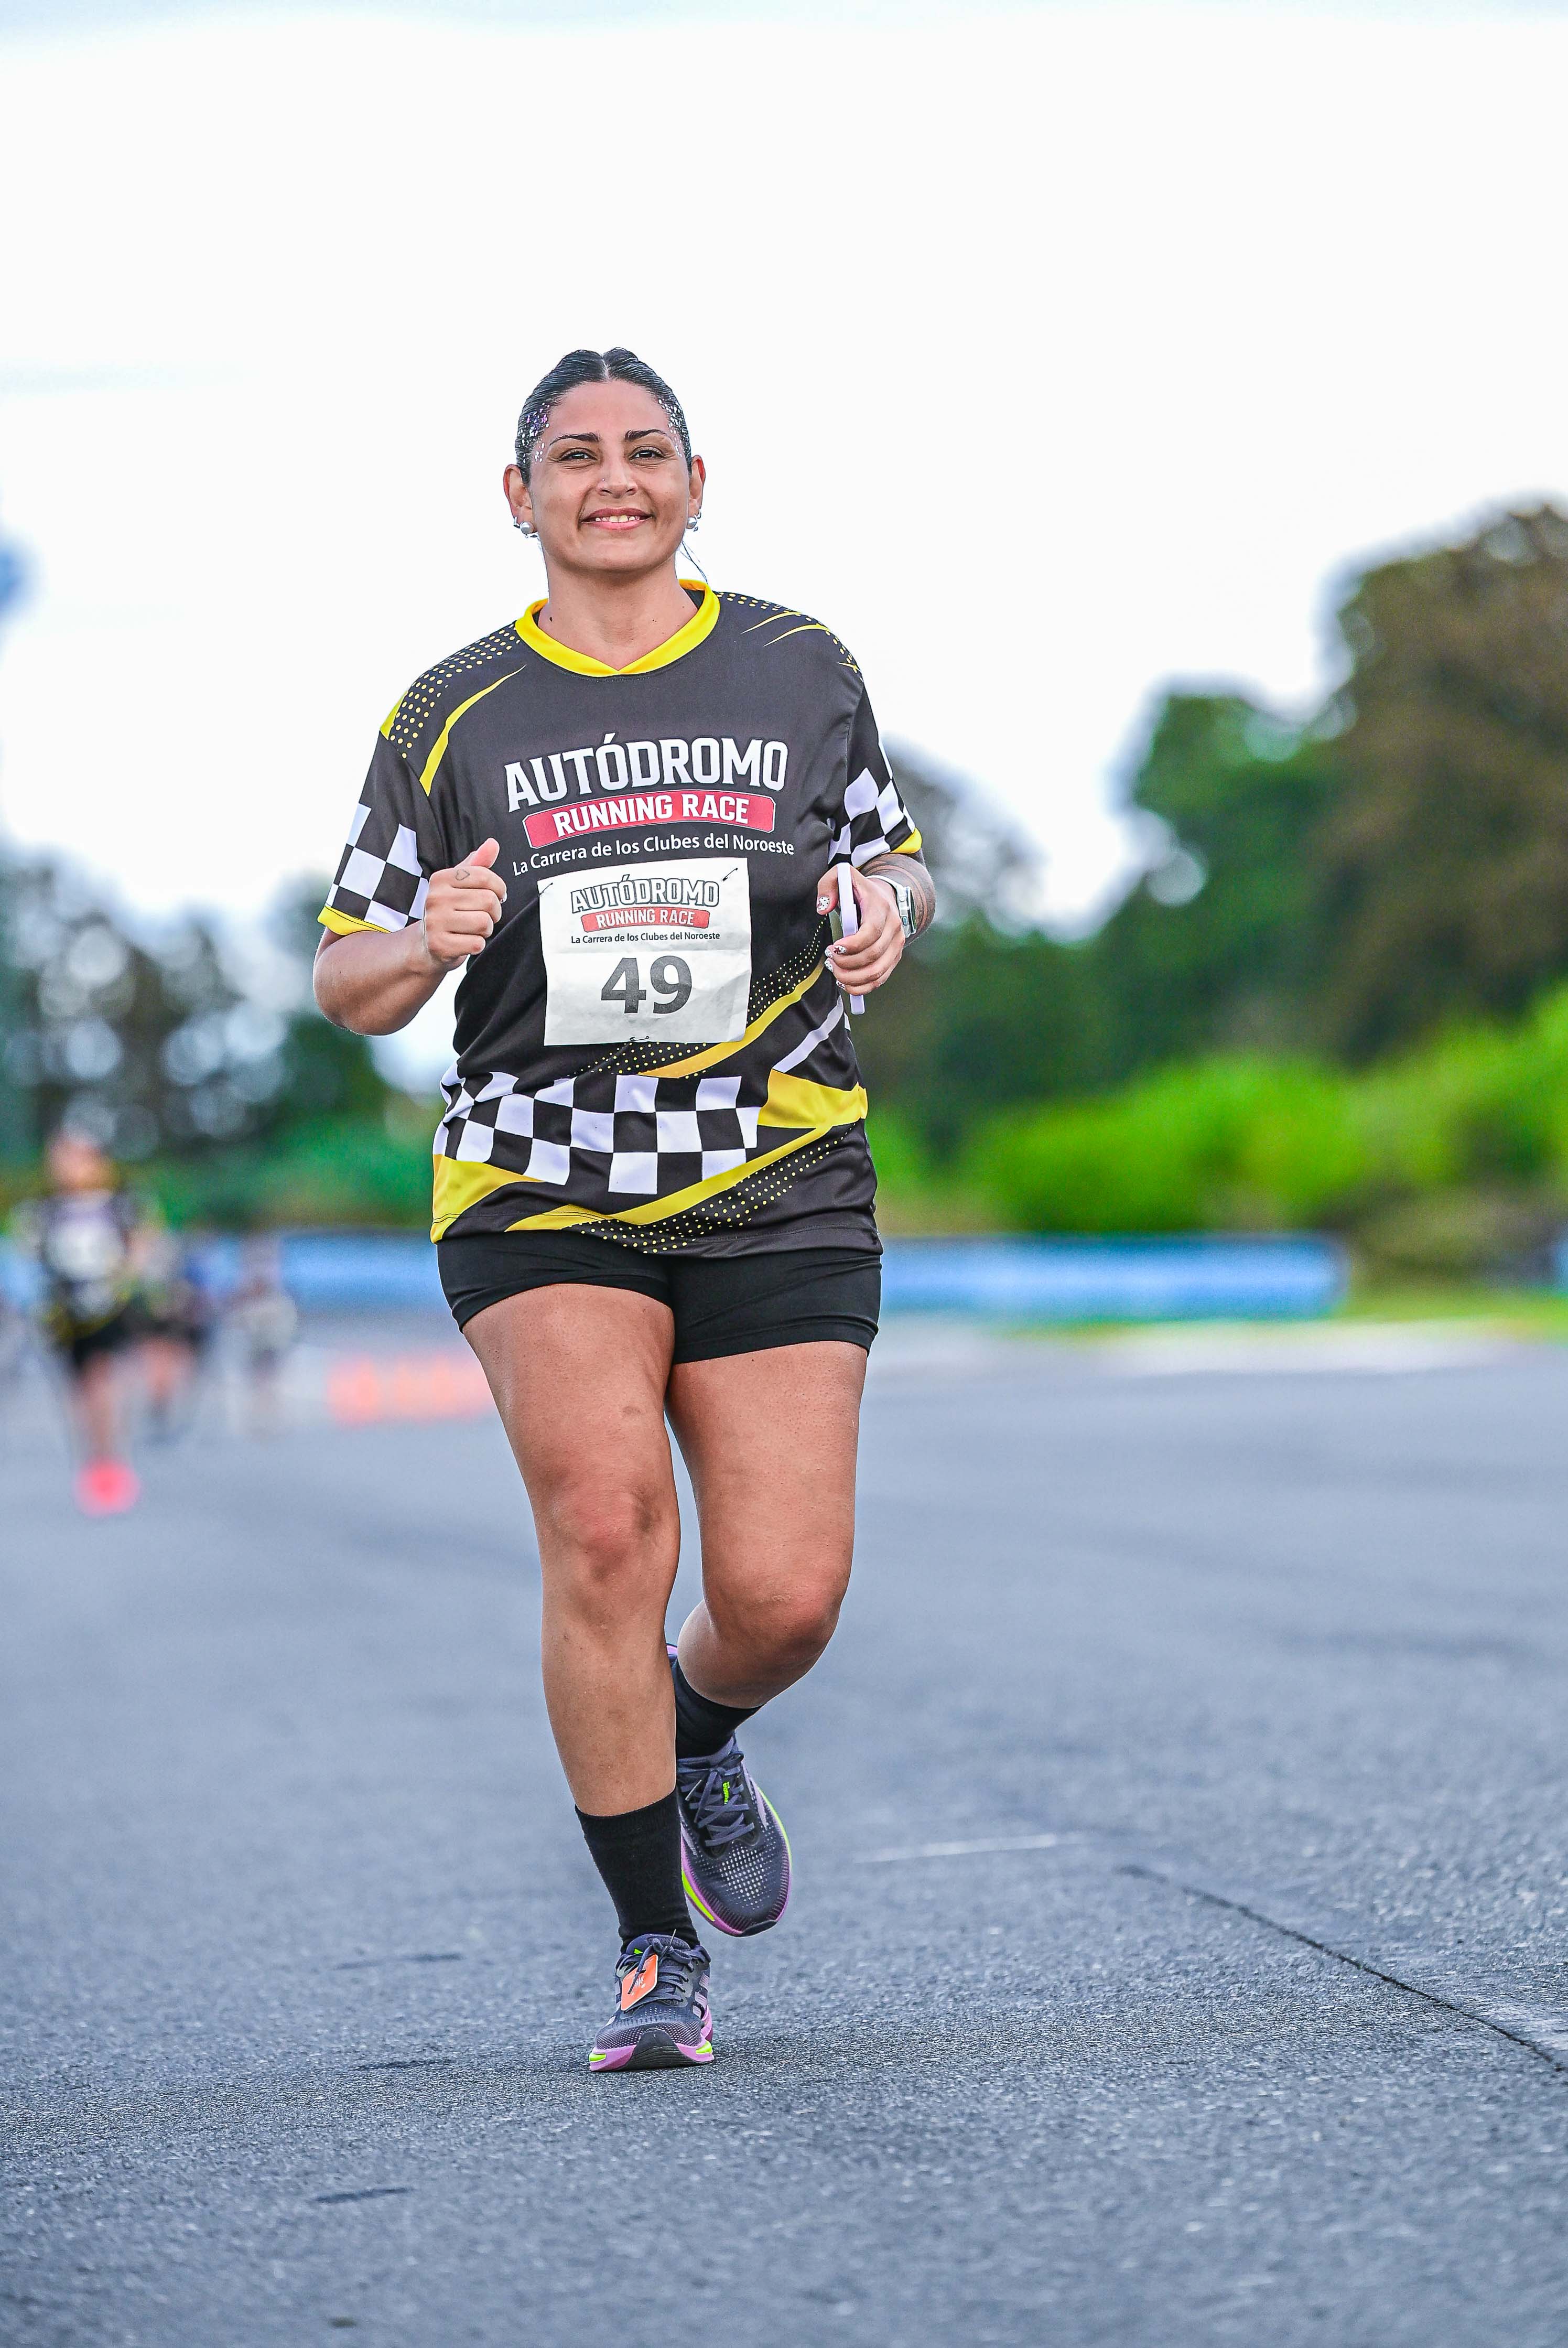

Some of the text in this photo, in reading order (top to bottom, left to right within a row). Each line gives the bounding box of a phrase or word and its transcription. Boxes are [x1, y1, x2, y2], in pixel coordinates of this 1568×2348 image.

[504, 732, 788, 812] AUTÓDROMO
[552, 794, 749, 837] RUNNING RACE
[513, 833, 794, 876] La Carrera de los Clubes del Noroeste
[570, 874, 720, 913] AUTÓDROMO
[582, 933, 612, 943] Carrera
[614, 933, 625, 942] de
[627, 933, 639, 942] los
[641, 932, 668, 941] Clubes
[670, 931, 683, 940] del
[684, 931, 721, 940] Noroeste
[596, 909, 695, 929] RUNNING RACE
[601, 955, 692, 1014] 49
